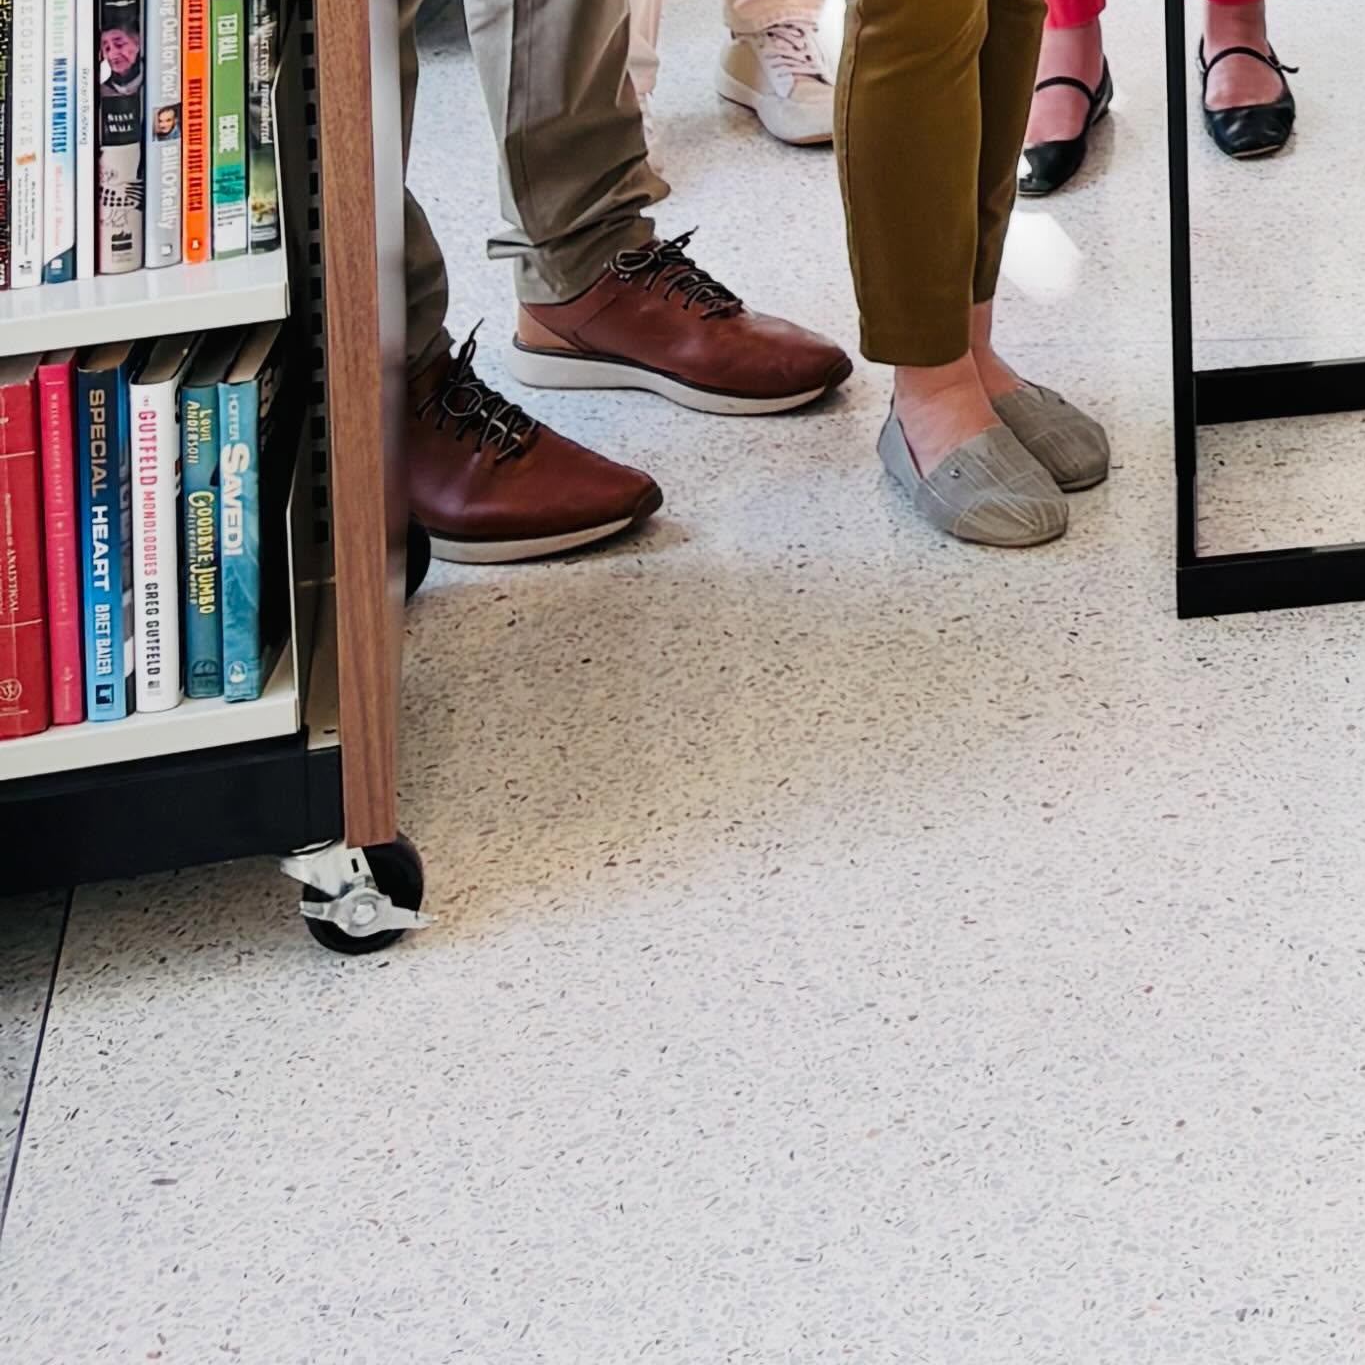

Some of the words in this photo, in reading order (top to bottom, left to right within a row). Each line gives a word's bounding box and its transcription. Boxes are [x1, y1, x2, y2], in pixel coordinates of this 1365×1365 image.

[162, 18, 178, 43] Out
[218, 13, 238, 36] TED
[52, 57, 67, 82] MIND
[163, 44, 179, 64] for
[217, 36, 238, 65] RALL
[52, 85, 67, 109] OVER
[162, 66, 178, 99] You?
[20, 98, 33, 146] LOVE
[52, 112, 67, 154] MATTERS
[161, 145, 177, 175] Bill
[158, 177, 178, 230] O'Reilly
[89, 388, 108, 498] SPECIAL
[138, 411, 158, 486] GUTFELD
[143, 490, 158, 577] MONOLOGUES
[188, 490, 215, 563] GOODBYE
[92, 505, 110, 592] HEART
[144, 582, 160, 616] GREG
[189, 563, 217, 614] JUMBO
[94, 603, 112, 636] BRET
[95, 638, 113, 676] BAIER
[145, 619, 161, 676] GUTFELD
